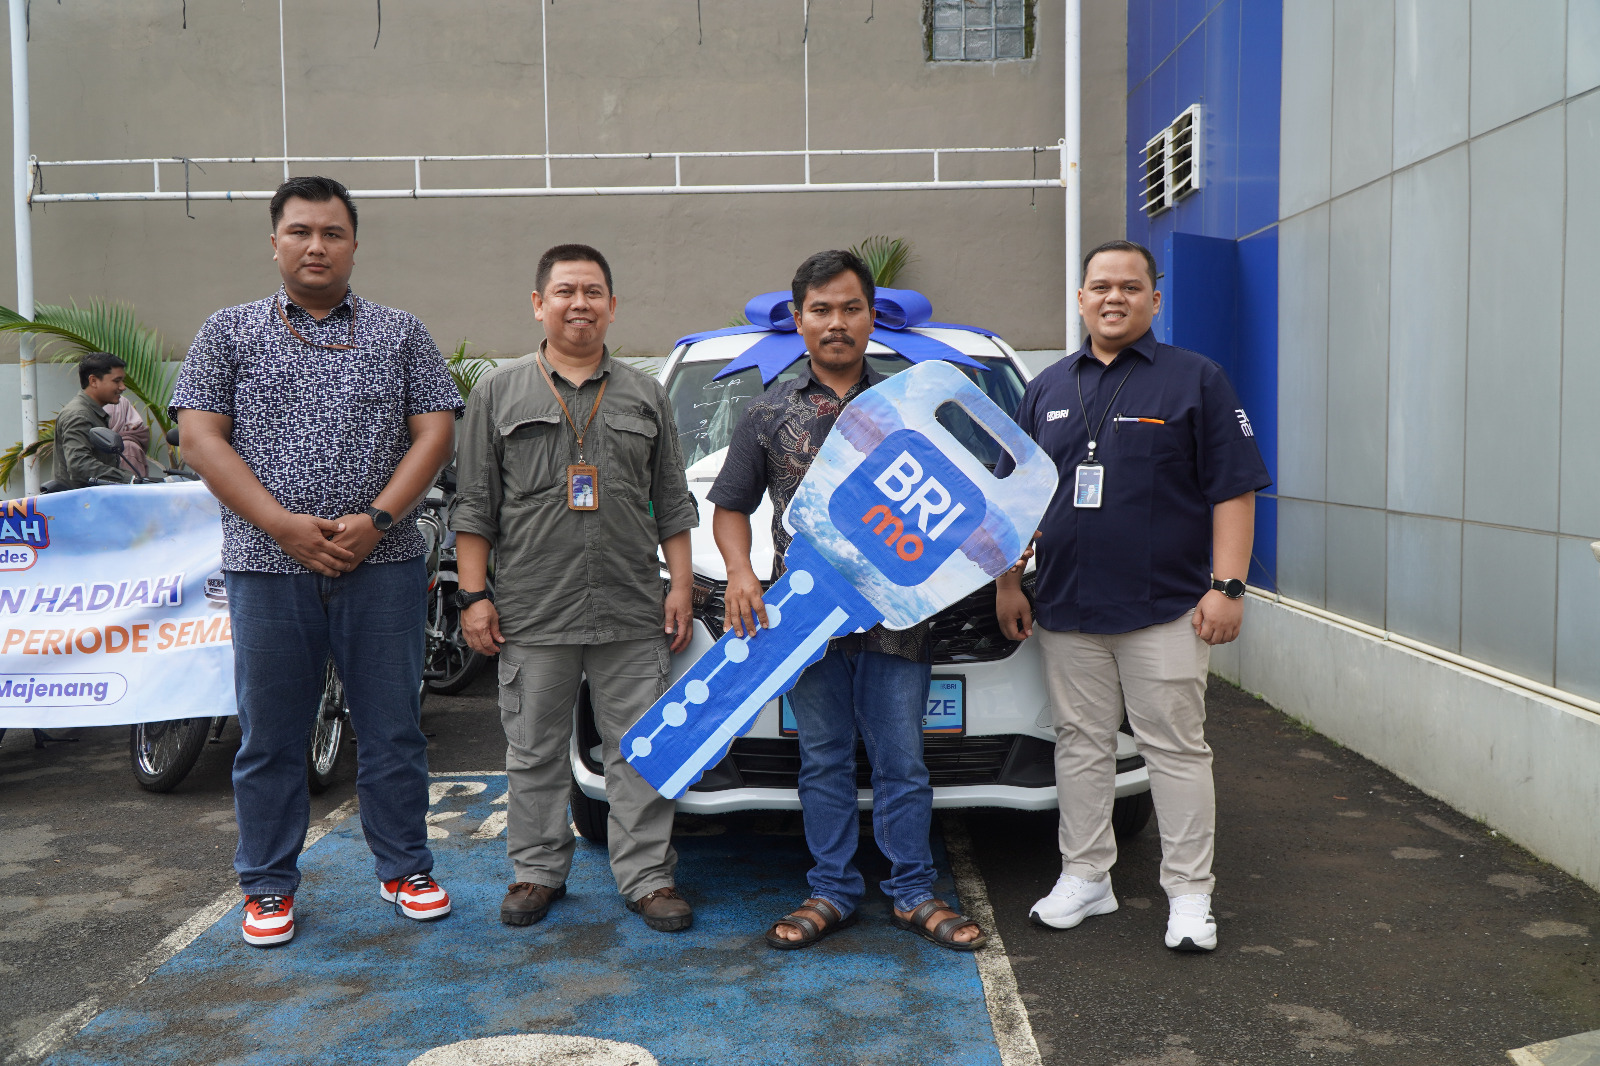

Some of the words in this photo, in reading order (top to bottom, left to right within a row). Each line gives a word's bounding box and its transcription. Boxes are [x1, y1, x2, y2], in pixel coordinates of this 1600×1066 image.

[873, 450, 966, 541] BRI
[861, 504, 924, 561] mo
[29, 576, 182, 613] HADIAH
[1, 623, 150, 655] PERIODE
[0, 678, 108, 703] Majenang
